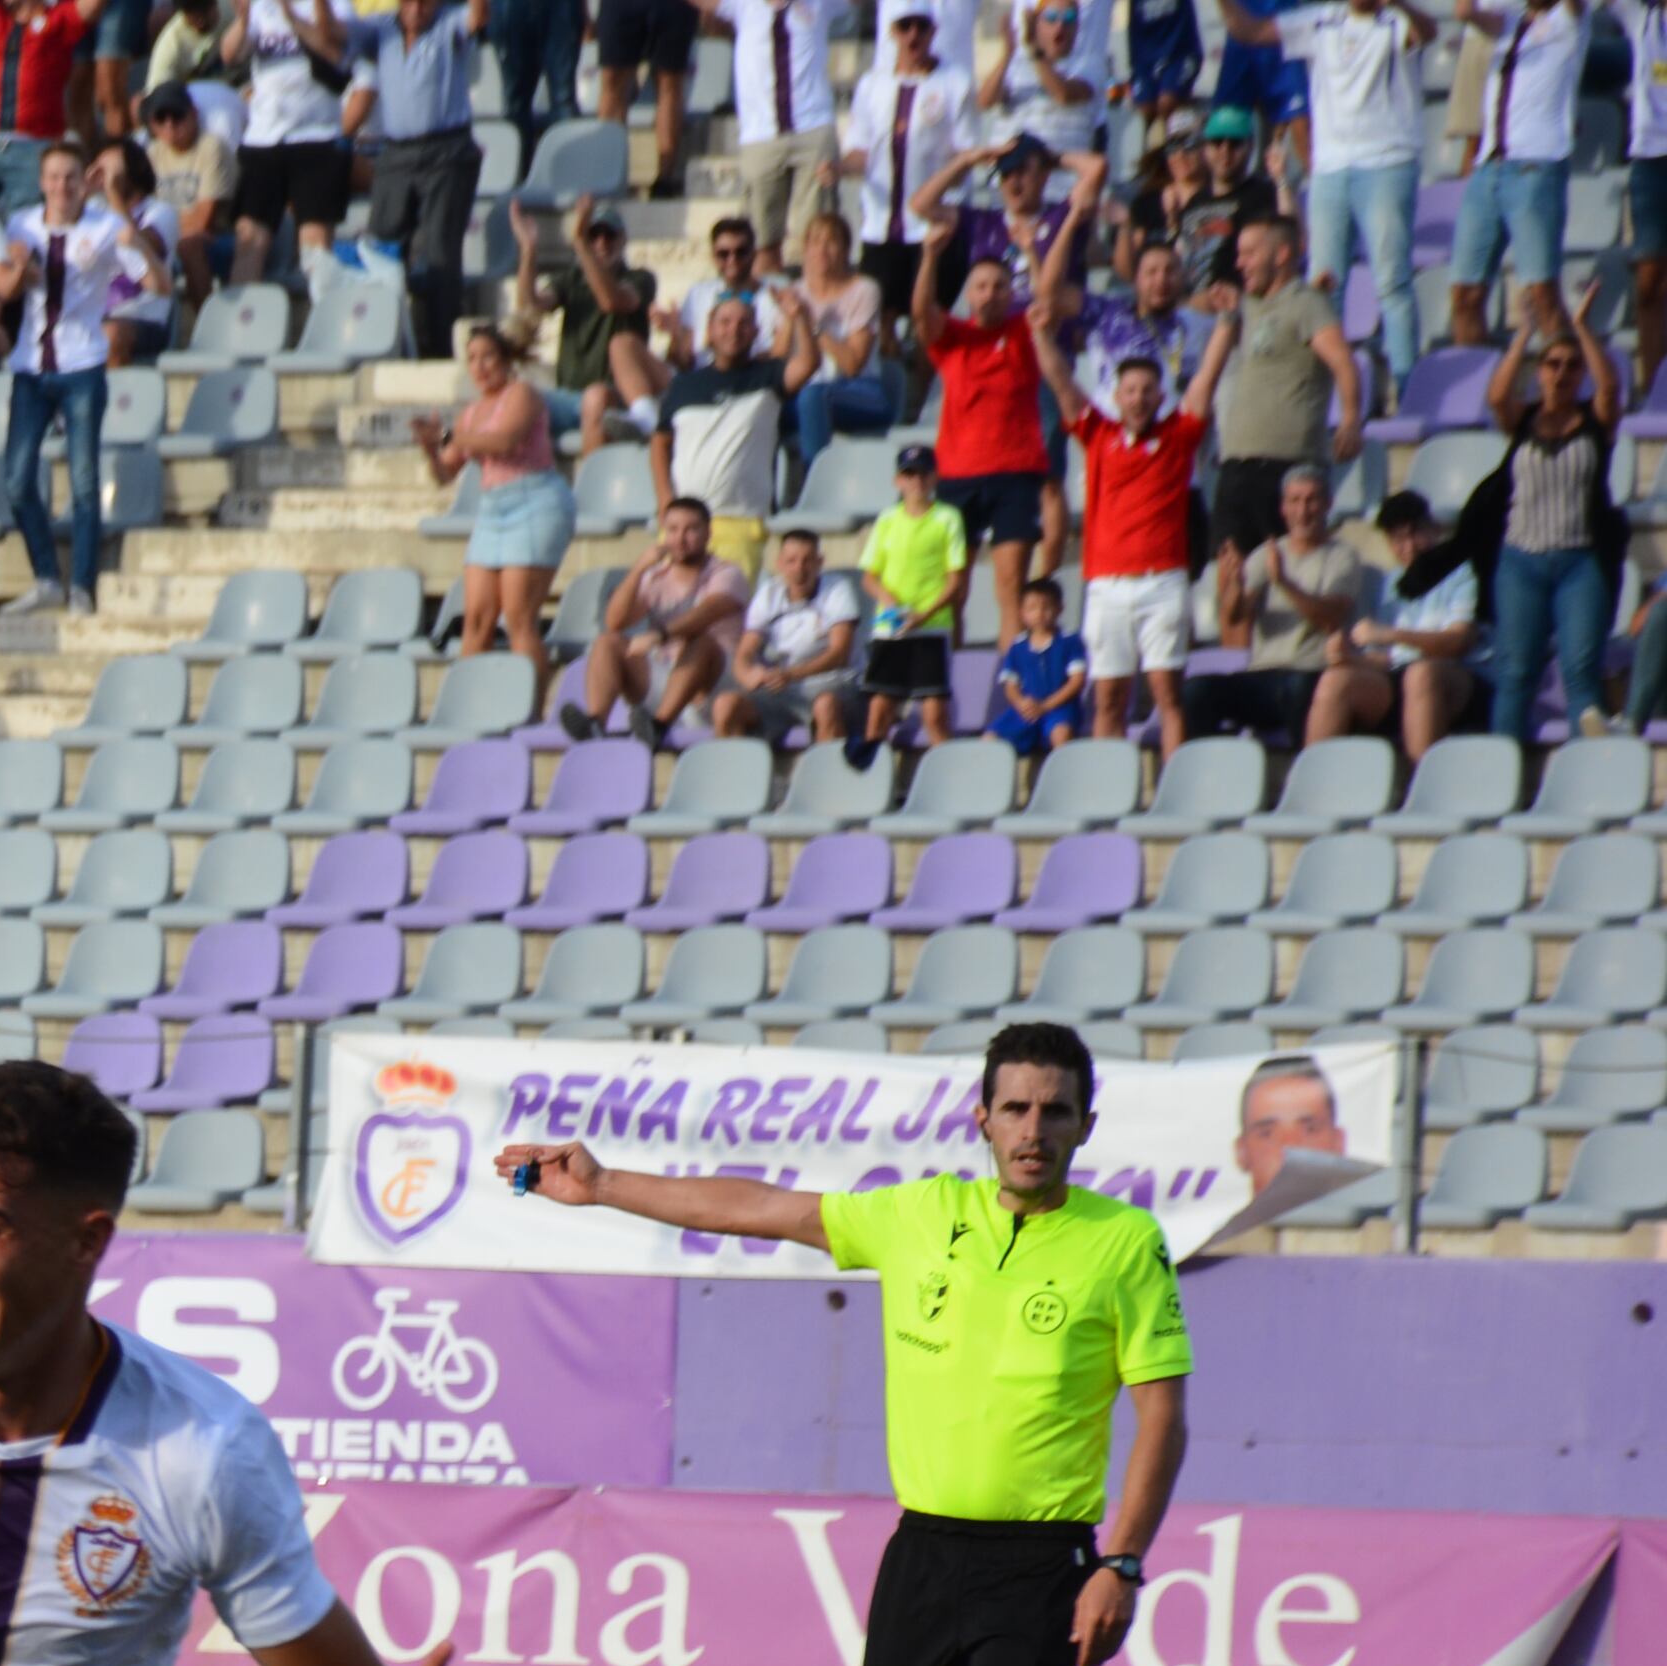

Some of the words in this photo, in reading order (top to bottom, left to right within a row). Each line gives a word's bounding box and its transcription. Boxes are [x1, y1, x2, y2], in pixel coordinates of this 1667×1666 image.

[502, 1055, 689, 1143] PEÑA
[700, 1076, 880, 1146] REAL
[269, 1417, 517, 1464] TIENDA
